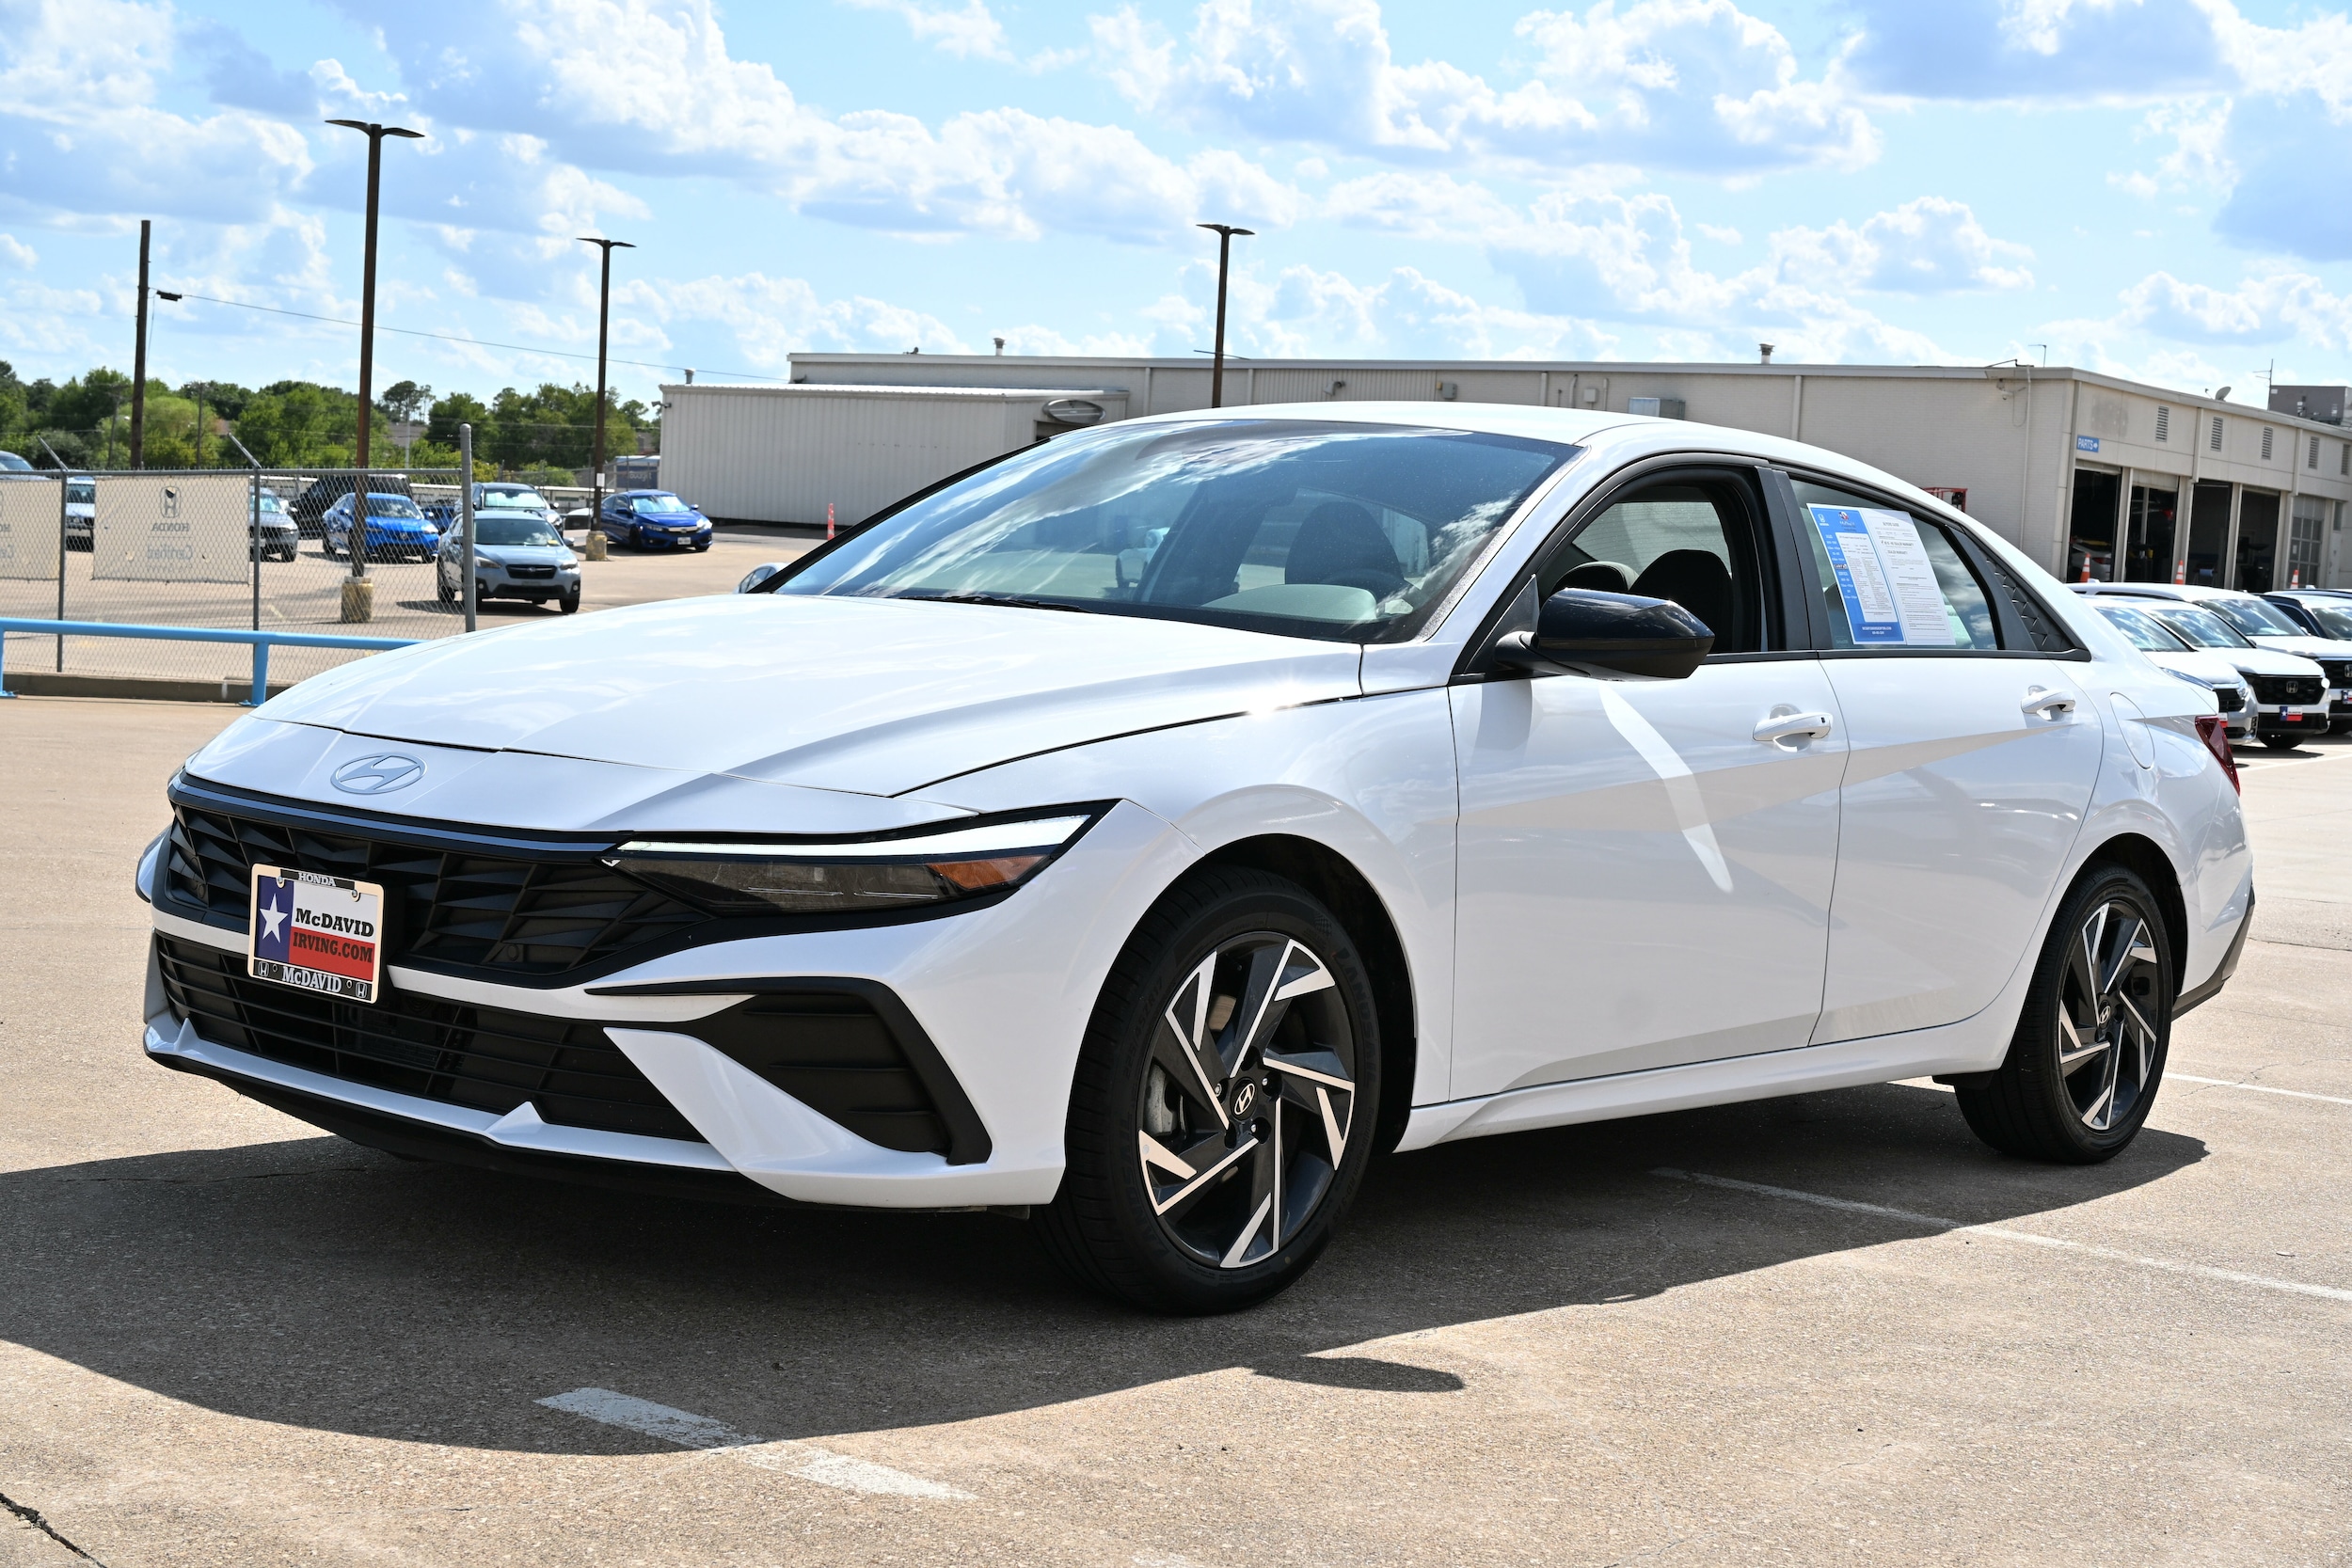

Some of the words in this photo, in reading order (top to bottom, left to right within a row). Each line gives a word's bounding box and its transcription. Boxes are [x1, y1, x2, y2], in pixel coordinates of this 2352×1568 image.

[2077, 437, 2093, 451] PARTS
[298, 872, 337, 887] HONDA
[294, 908, 374, 938] McDAVID
[293, 931, 373, 963] IRVING.COM
[282, 966, 342, 993] McDAVID
